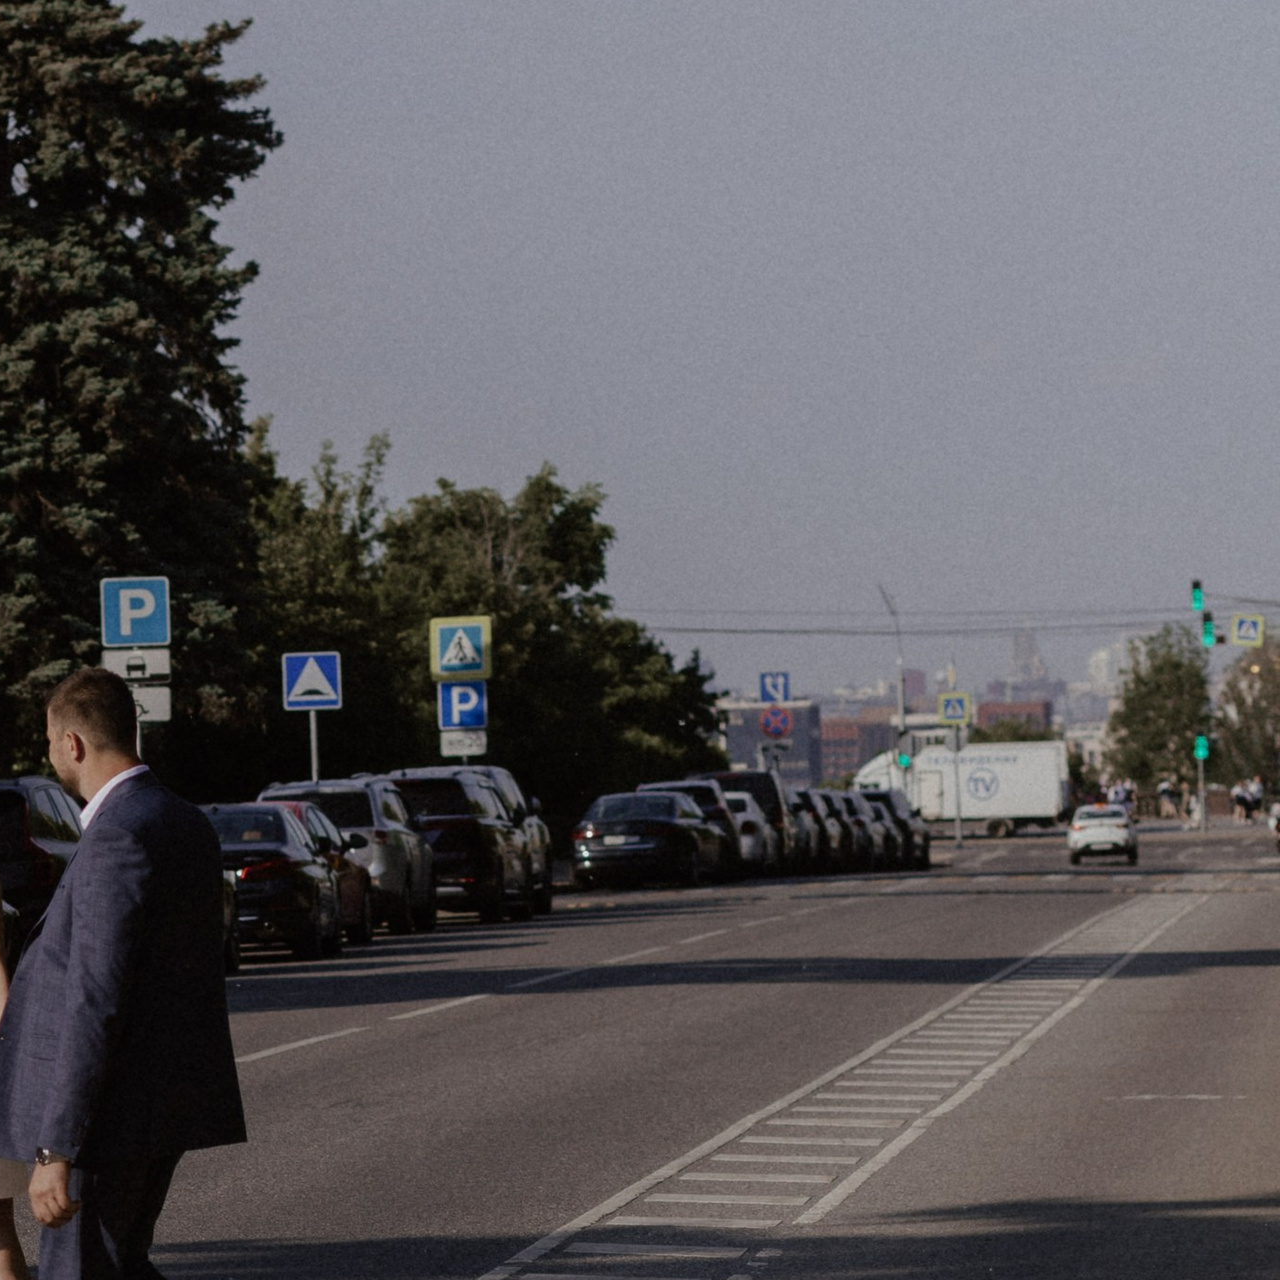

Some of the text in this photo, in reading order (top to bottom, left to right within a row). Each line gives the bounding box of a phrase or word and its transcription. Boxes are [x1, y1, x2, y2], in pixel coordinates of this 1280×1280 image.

[119, 588, 156, 636] P
[451, 686, 479, 724] P
[970, 776, 998, 793] TV
